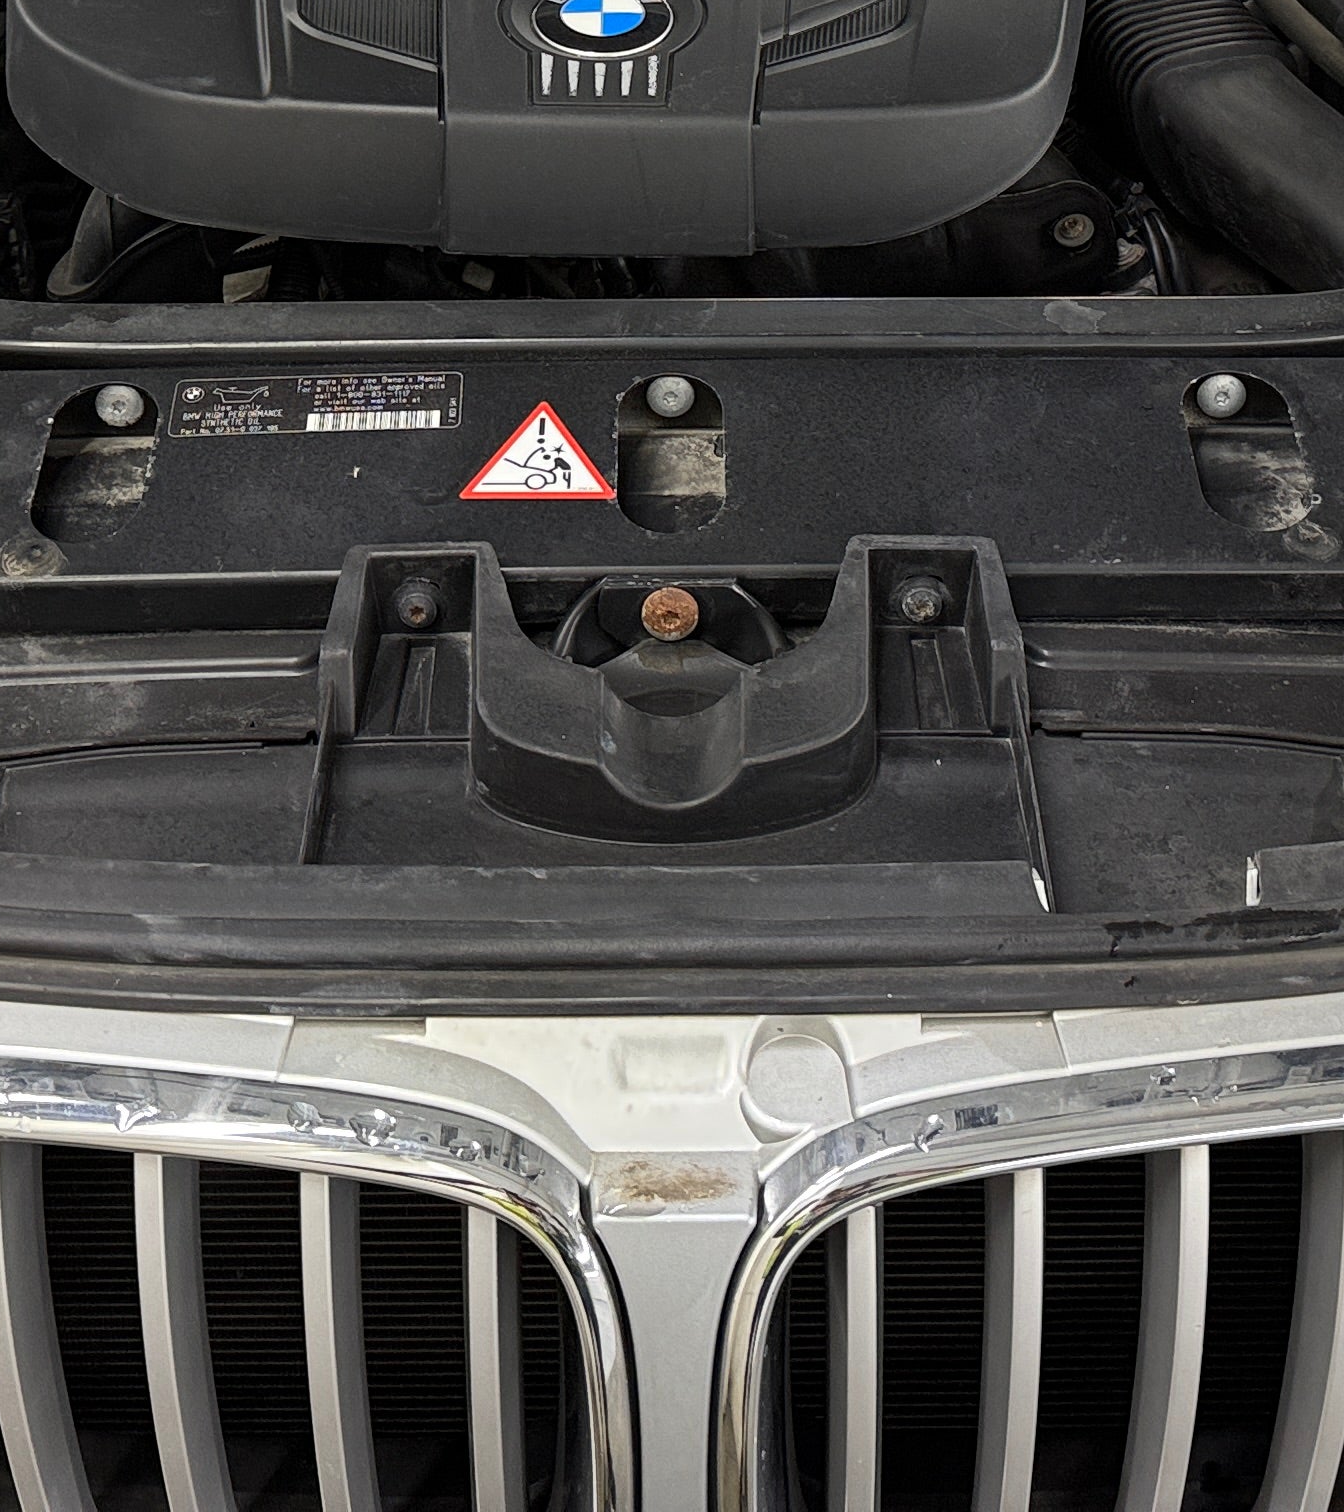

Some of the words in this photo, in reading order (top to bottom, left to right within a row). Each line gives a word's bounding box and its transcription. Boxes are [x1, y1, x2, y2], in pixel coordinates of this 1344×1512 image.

[297, 377, 312, 386] For
[381, 375, 413, 384] Owner's
[417, 374, 445, 382] Manual
[297, 385, 312, 393] For
[326, 384, 341, 392] list
[359, 383, 382, 391] other
[387, 382, 425, 392] approved
[428, 382, 445, 390] oils
[391, 396, 408, 404] site
[238, 402, 262, 411] only
[182, 411, 202, 421] BMW
[205, 411, 225, 419] HIGH
[228, 409, 284, 418] PERFORMANCE
[200, 418, 244, 427] SYNTHETIC
[247, 417, 261, 425] OIL
